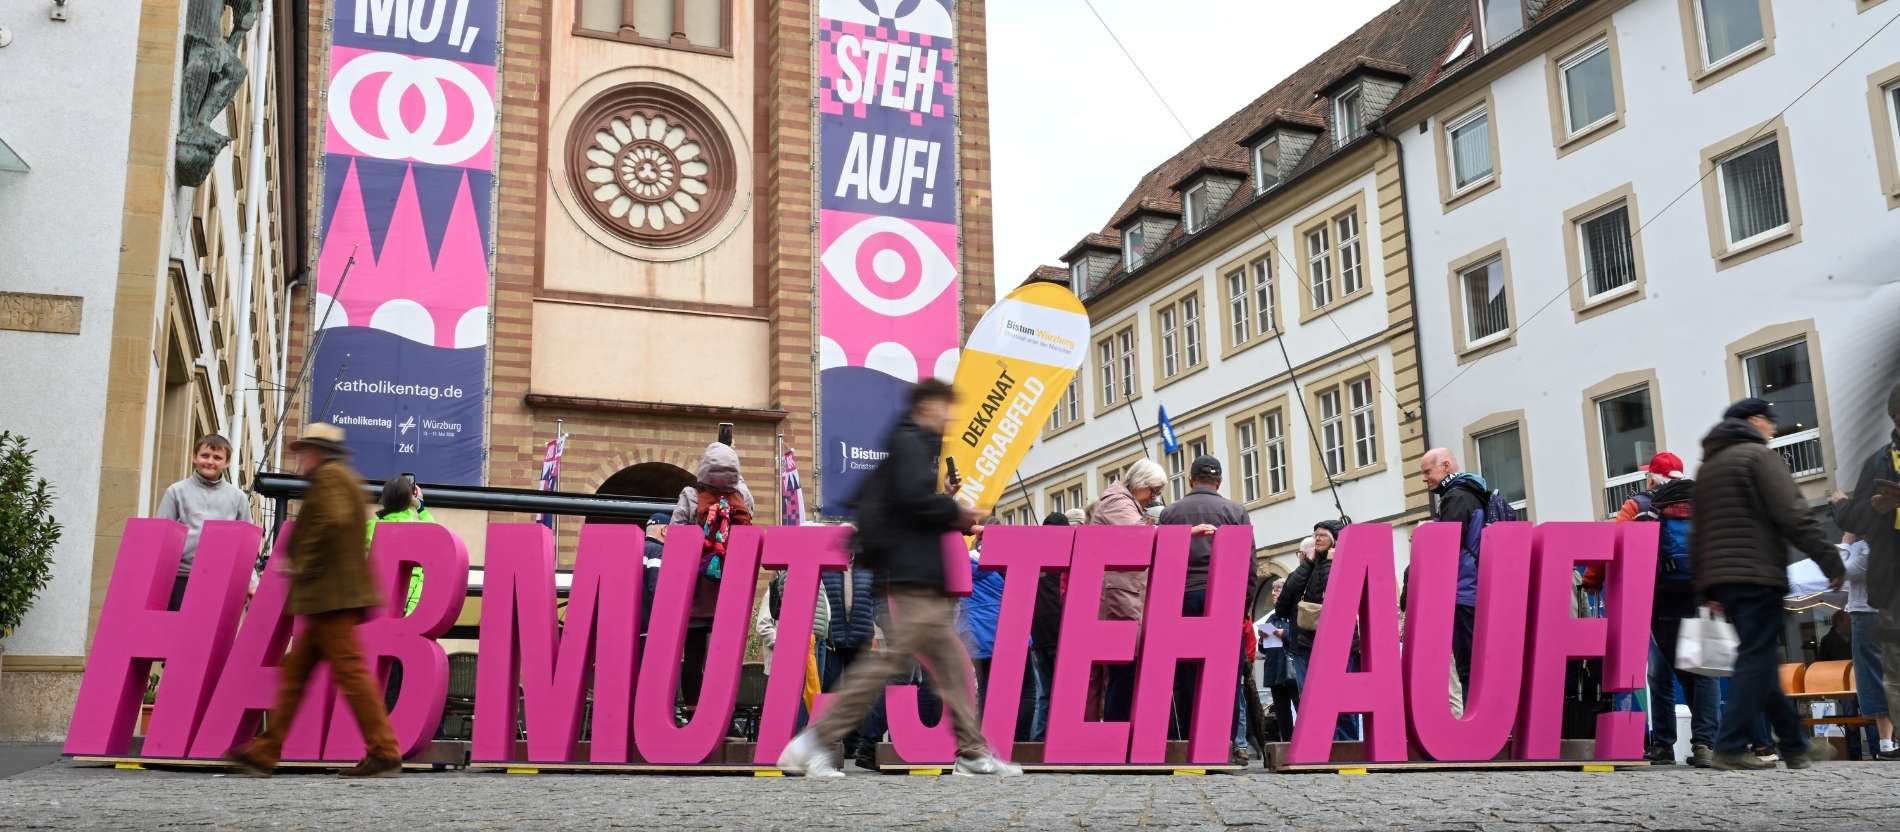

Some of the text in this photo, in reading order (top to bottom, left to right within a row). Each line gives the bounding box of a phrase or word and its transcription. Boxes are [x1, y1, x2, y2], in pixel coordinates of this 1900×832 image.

[836, 35, 938, 113] STEH
[835, 131, 941, 208] AUF!
[1007, 319, 1035, 336] Bistum
[335, 379, 463, 399] katholikentag.de
[961, 370, 1015, 448] DEKANAT
[333, 414, 392, 428] Katholikentag
[422, 418, 462, 432] Würzburg
[399, 443, 414, 454] ZdK
[851, 447, 889, 460] Bistum
[63, 518, 469, 762] HAB
[1284, 521, 1660, 763] AUF!
